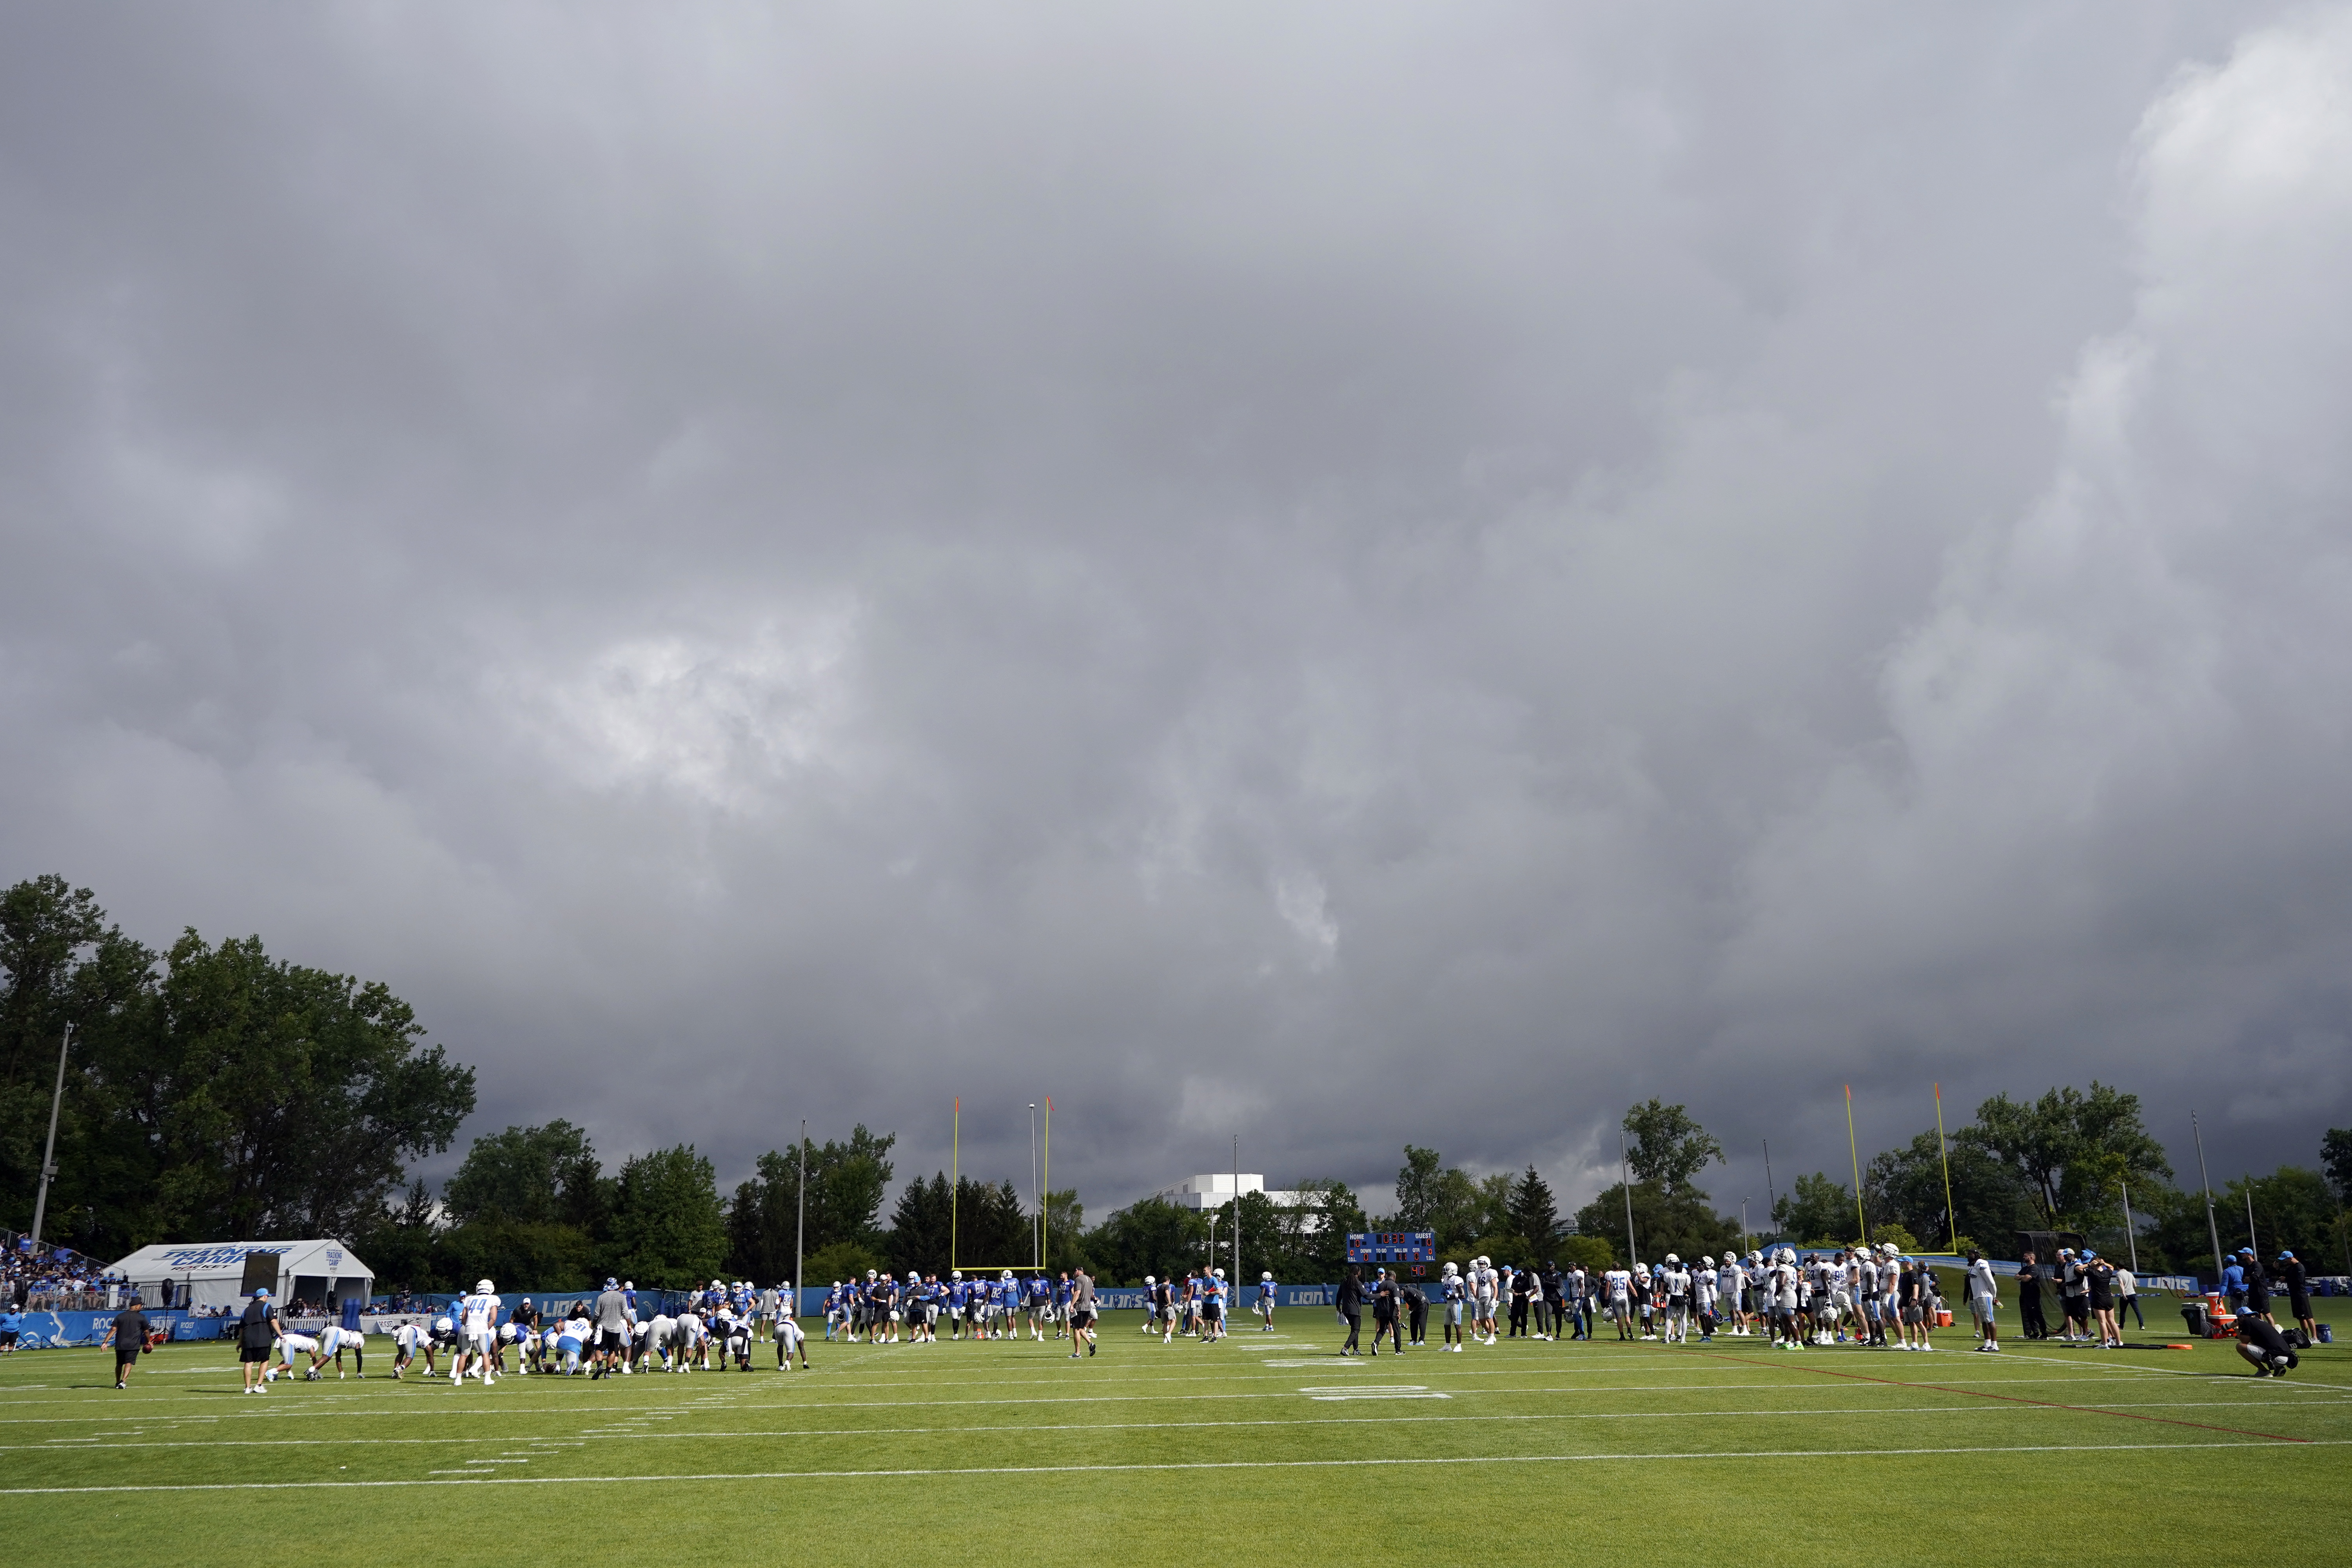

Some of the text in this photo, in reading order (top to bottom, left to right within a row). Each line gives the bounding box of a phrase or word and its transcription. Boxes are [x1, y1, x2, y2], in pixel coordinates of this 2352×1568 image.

[1383, 1234, 1405, 1243] 0:33
[161, 1248, 293, 1258] TRAINING
[1363, 1253, 1368, 1261] 0
[171, 1255, 247, 1265] CAMP
[1412, 1266, 1425, 1276] 40
[975, 1283, 984, 1294] 60
[1007, 1281, 1016, 1292] 65
[1031, 1283, 1041, 1294] 73
[1612, 1277, 1625, 1290] 35
[1675, 1278, 1679, 1292] 1
[2147, 1276, 2190, 1291] LIONS
[953, 1286, 961, 1295] 70
[991, 1287, 1002, 1298] 82
[1269, 1285, 1273, 1295] 5
[831, 1296, 839, 1304] 36
[1100, 1294, 1144, 1308] LIONS
[1289, 1291, 1333, 1305] LIONS
[468, 1299, 487, 1314] 44
[92, 1317, 115, 1330] ROC
[572, 1323, 586, 1332] 91
